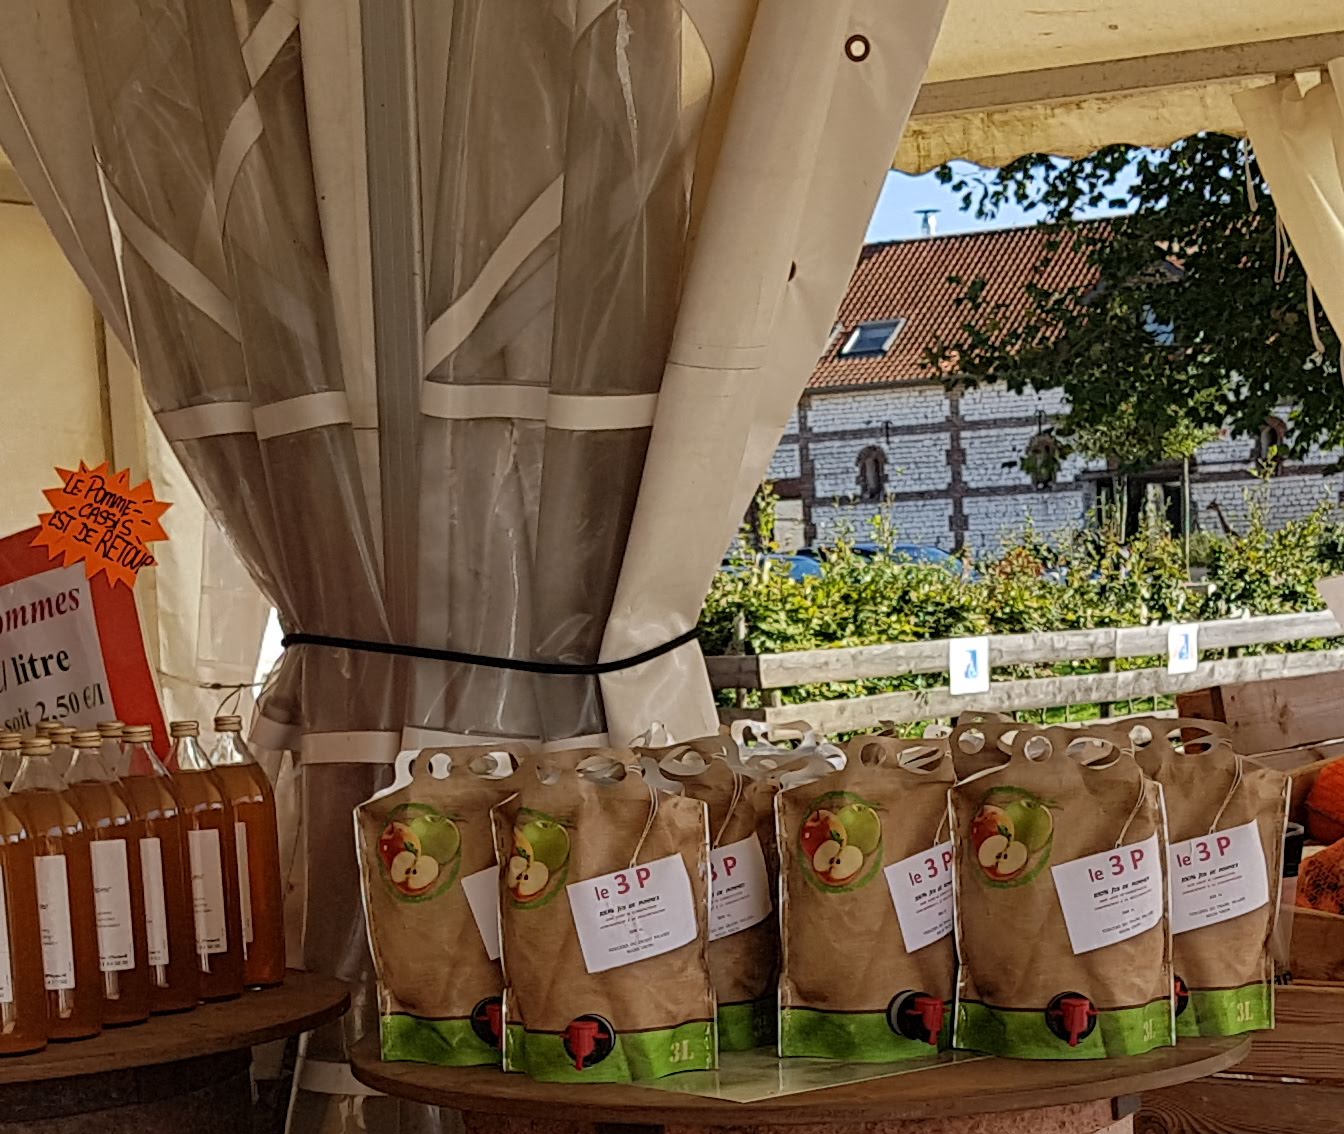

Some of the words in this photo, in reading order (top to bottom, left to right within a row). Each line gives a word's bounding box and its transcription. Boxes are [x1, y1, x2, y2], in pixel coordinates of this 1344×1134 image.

[63, 472, 85, 496] LE
[78, 503, 134, 537] CASSIS
[48, 510, 77, 534] EST
[73, 522, 99, 546] DE
[94, 529, 156, 575] RETOUR
[11, 649, 72, 686] litre
[4, 707, 33, 733] soit
[722, 856, 737, 877] P
[908, 871, 923, 887] le
[924, 858, 939, 879] 3
[941, 850, 952, 872] P
[1088, 868, 1105, 883] le
[1108, 854, 1125, 876] 3
[1130, 848, 1145, 870] P
[1176, 854, 1192, 868] le
[1195, 841, 1211, 862] 3
[1216, 836, 1231, 857] P
[594, 886, 610, 902] le
[614, 873, 631, 895] 3
[635, 867, 652, 889] P
[1236, 1001, 1254, 1023] 3L
[669, 1039, 696, 1063] 3L
